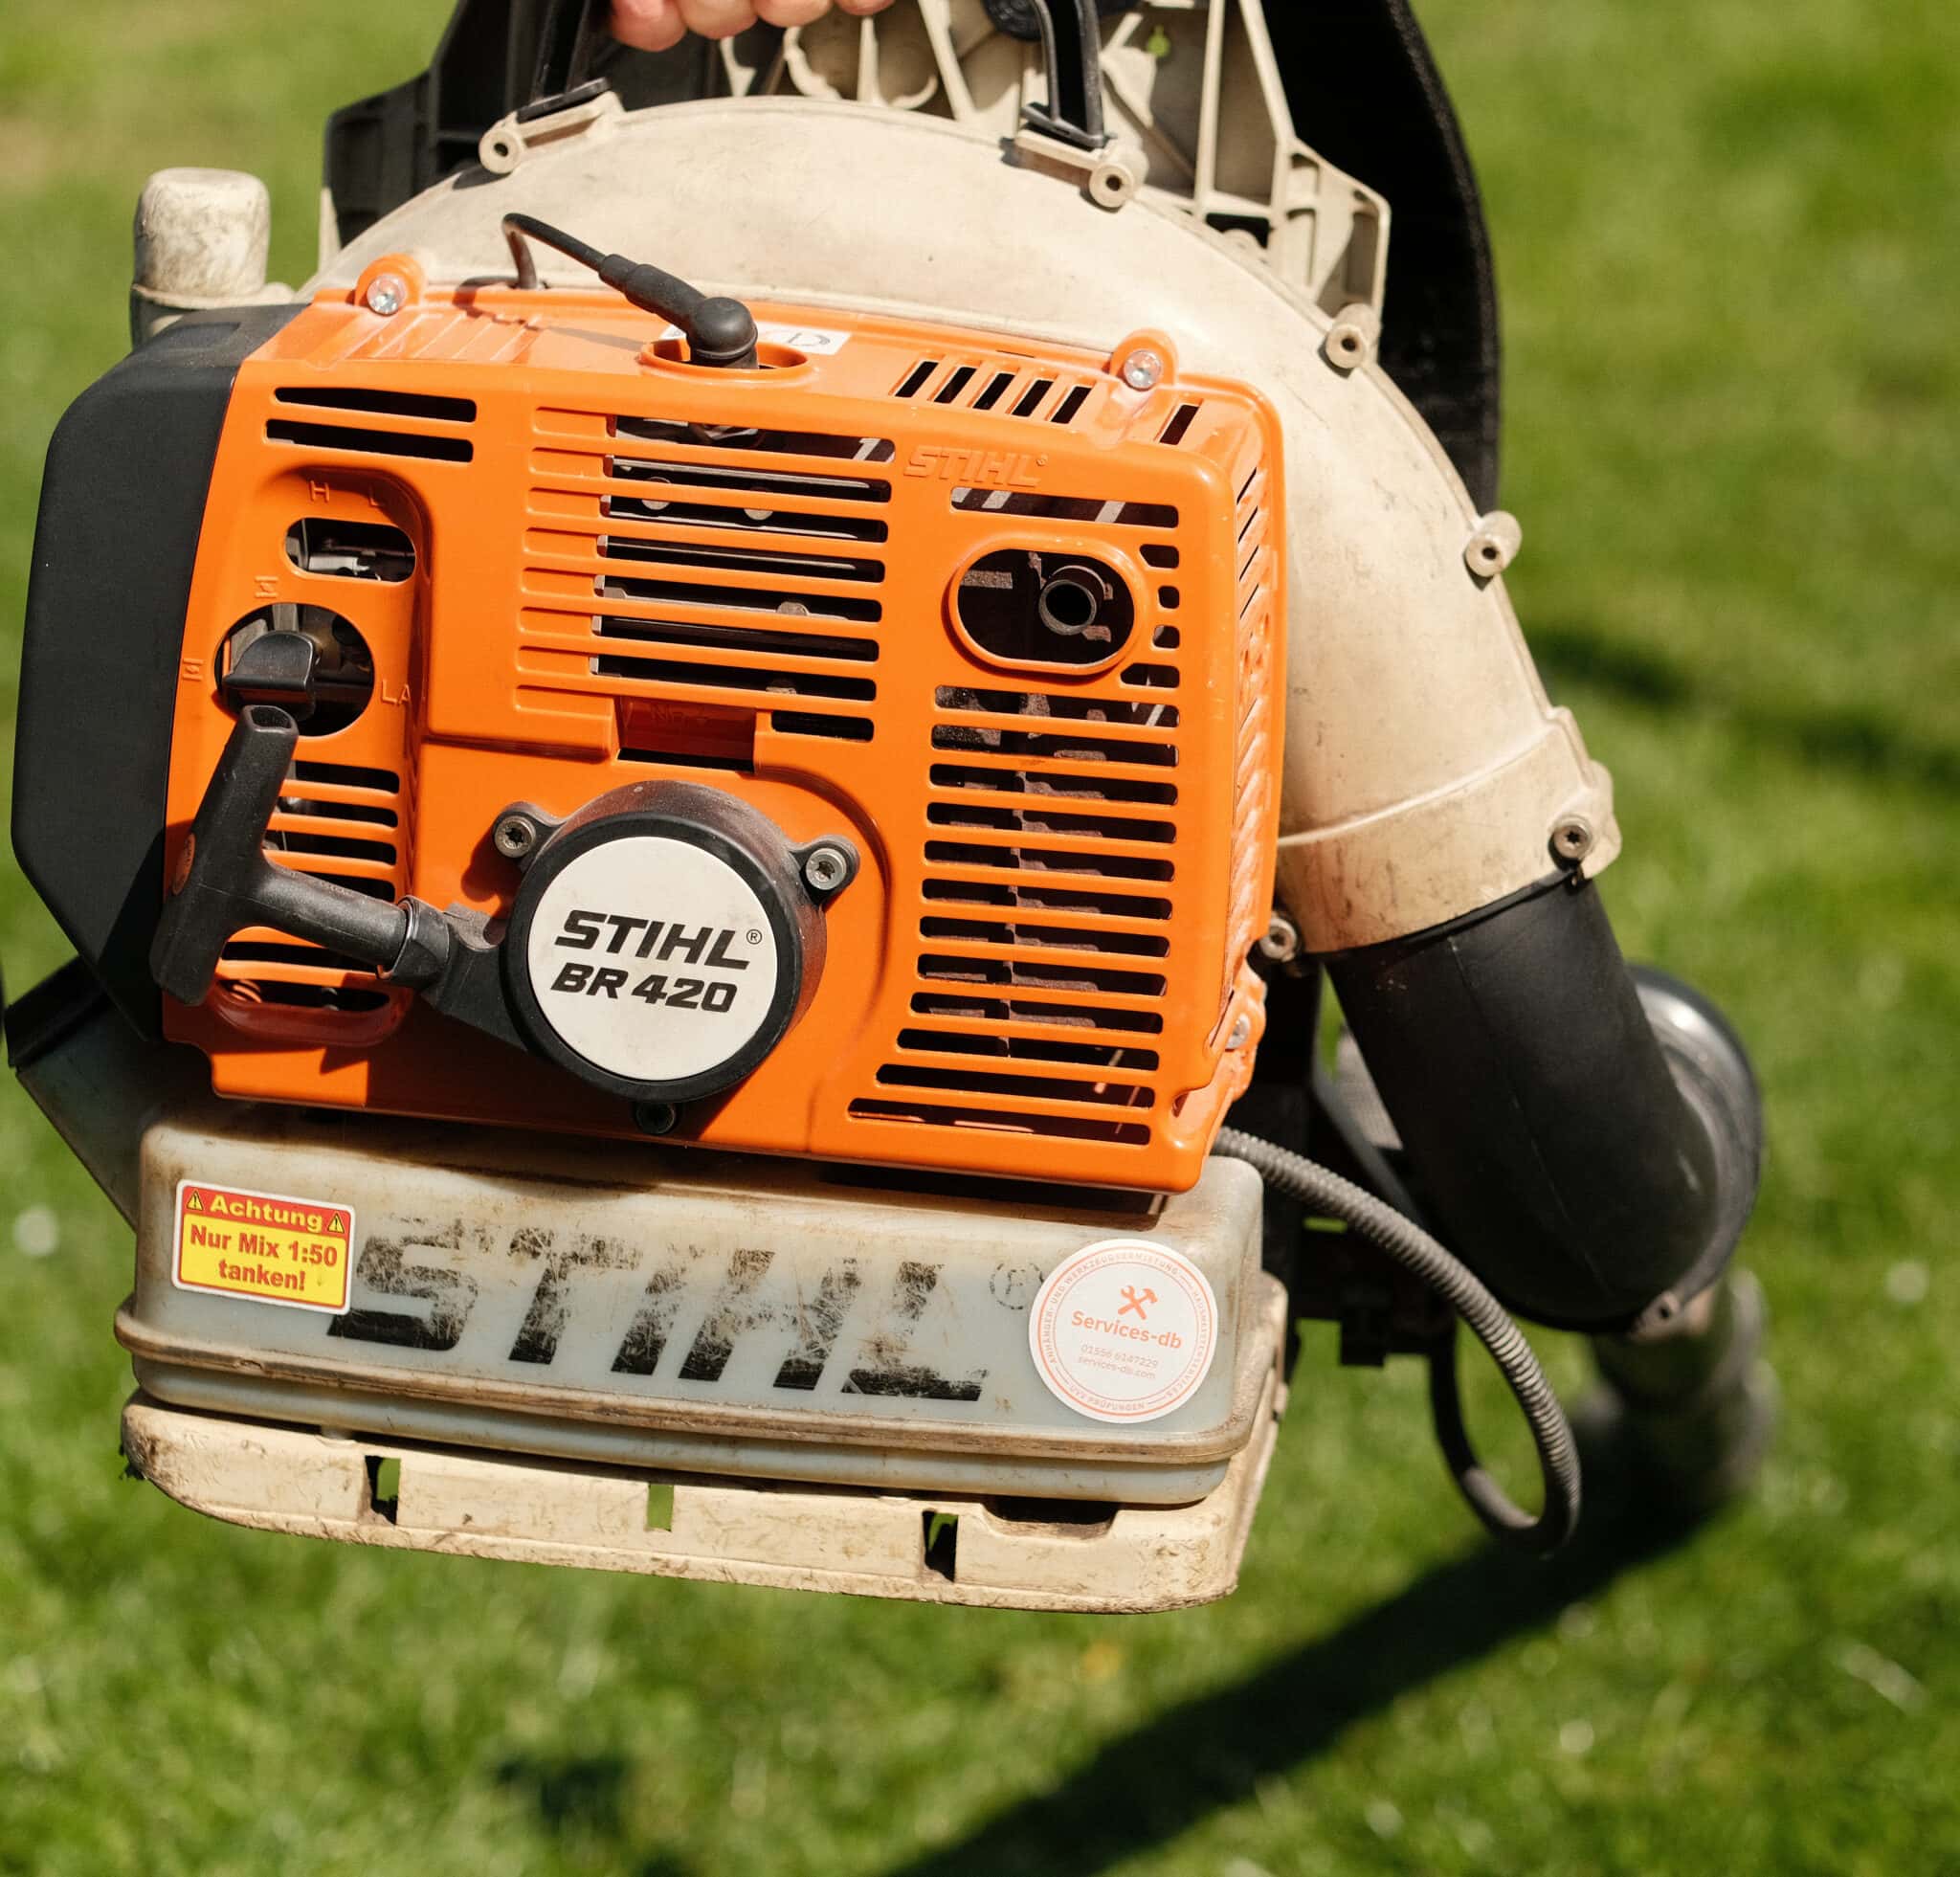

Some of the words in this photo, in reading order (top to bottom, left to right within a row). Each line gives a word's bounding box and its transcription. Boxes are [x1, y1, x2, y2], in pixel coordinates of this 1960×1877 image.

[550, 962, 629, 999] BR
[631, 974, 738, 1014] 420
[210, 1195, 323, 1234] Achtung
[190, 1223, 232, 1249] Nur
[238, 1233, 279, 1259] Mix
[288, 1240, 338, 1266] 1:50
[218, 1259, 306, 1291] tanken!
[1071, 1310, 1182, 1349] Services-db
